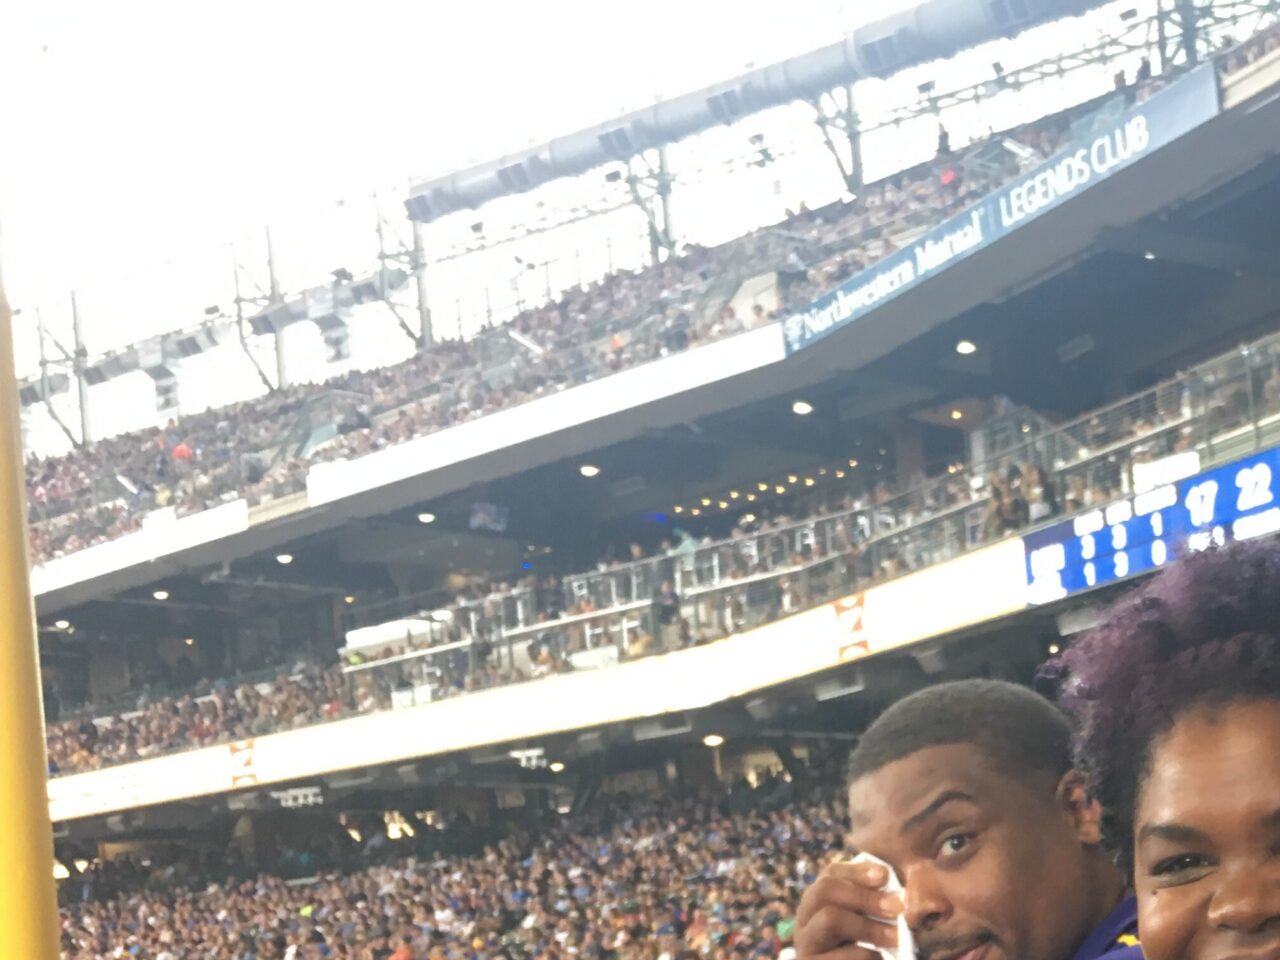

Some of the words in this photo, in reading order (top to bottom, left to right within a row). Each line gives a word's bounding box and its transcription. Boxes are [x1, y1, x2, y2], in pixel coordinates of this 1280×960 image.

[804, 258, 914, 338] Northwestern
[1000, 152, 1091, 227] LEGENDS
[1091, 115, 1149, 174] CLUB
[1235, 463, 1273, 511] 22
